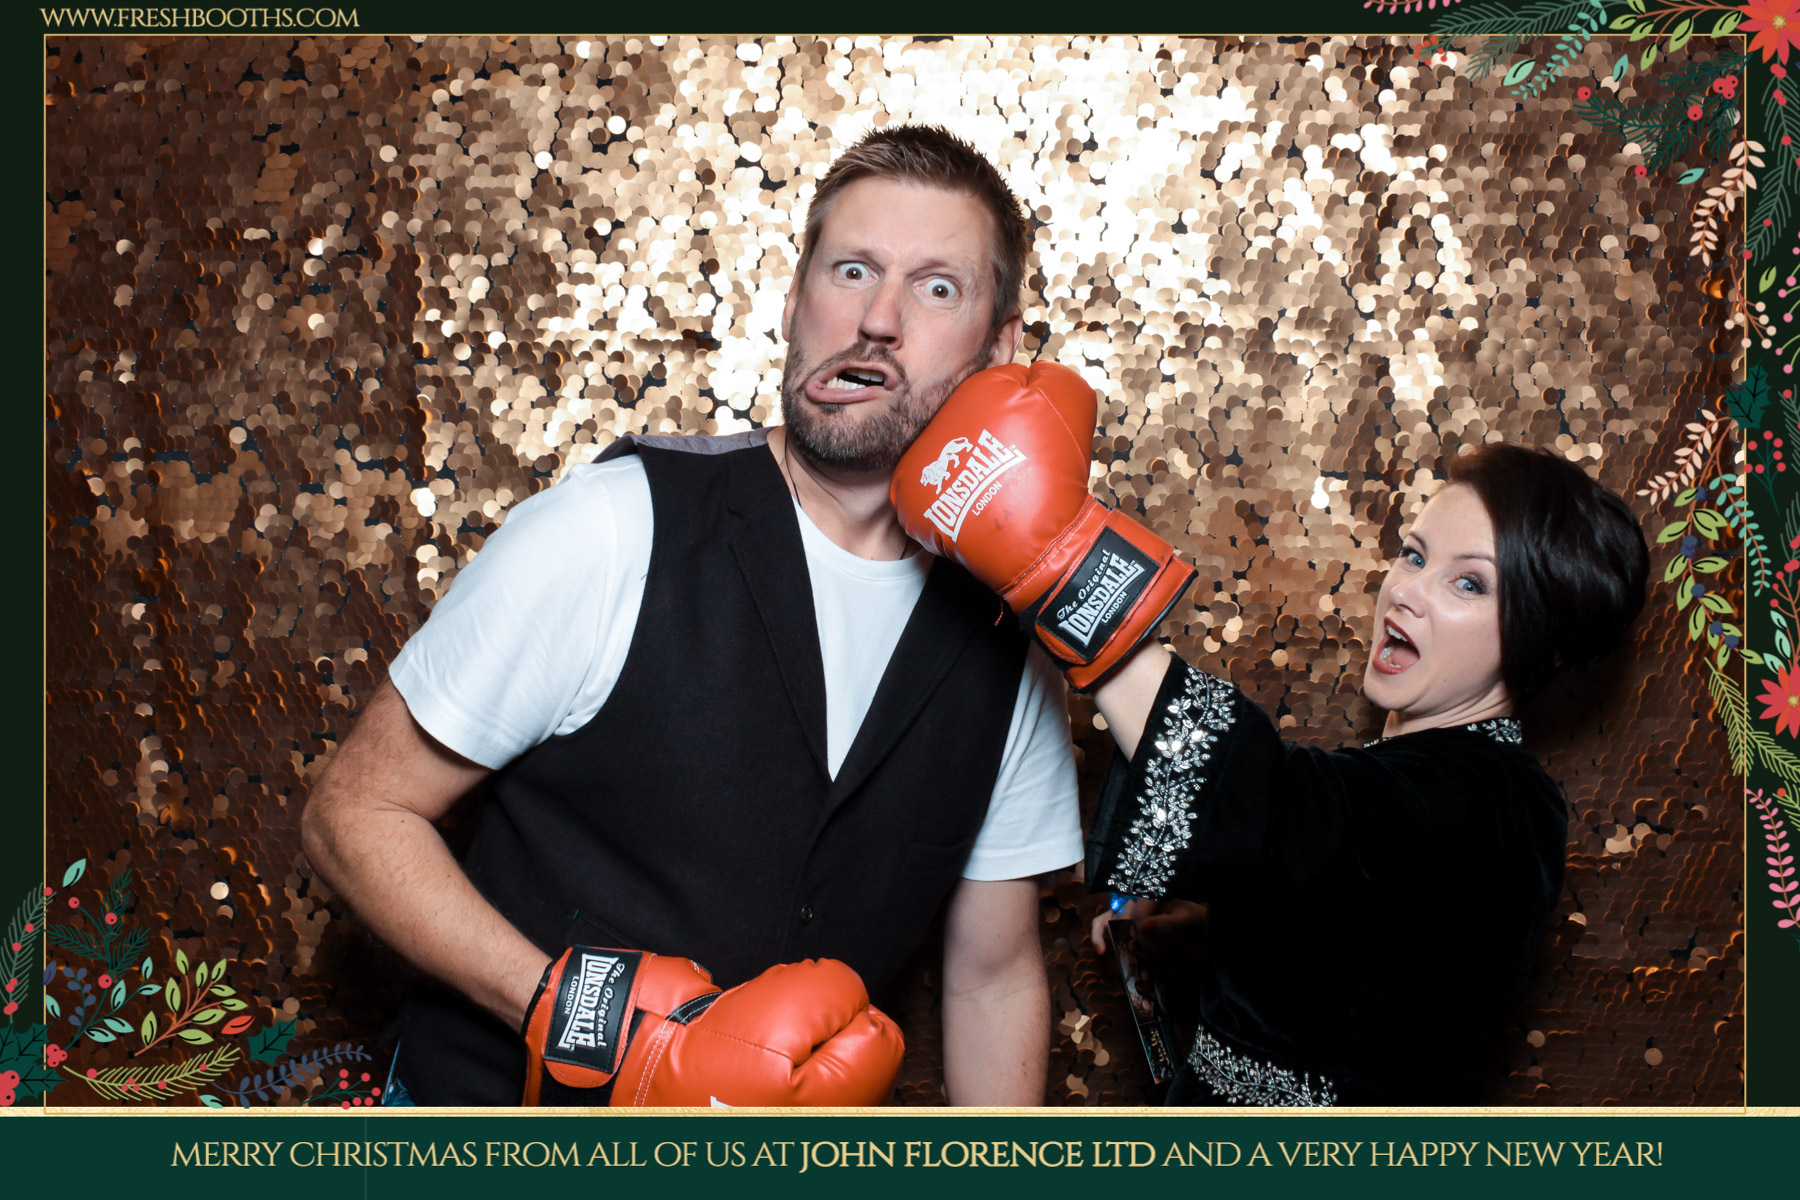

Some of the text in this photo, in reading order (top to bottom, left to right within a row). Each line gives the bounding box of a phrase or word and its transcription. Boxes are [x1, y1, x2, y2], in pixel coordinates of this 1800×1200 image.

[923, 429, 1027, 543] LONSDALE
[971, 480, 1003, 516] LONDON
[1057, 549, 1111, 620] The Original
[1058, 553, 1146, 647] LONSDALE
[1101, 591, 1128, 624] LONDON
[558, 954, 620, 1048] LONSDALE
[564, 976, 580, 1015] LONDON
[597, 963, 625, 1047] The Original
